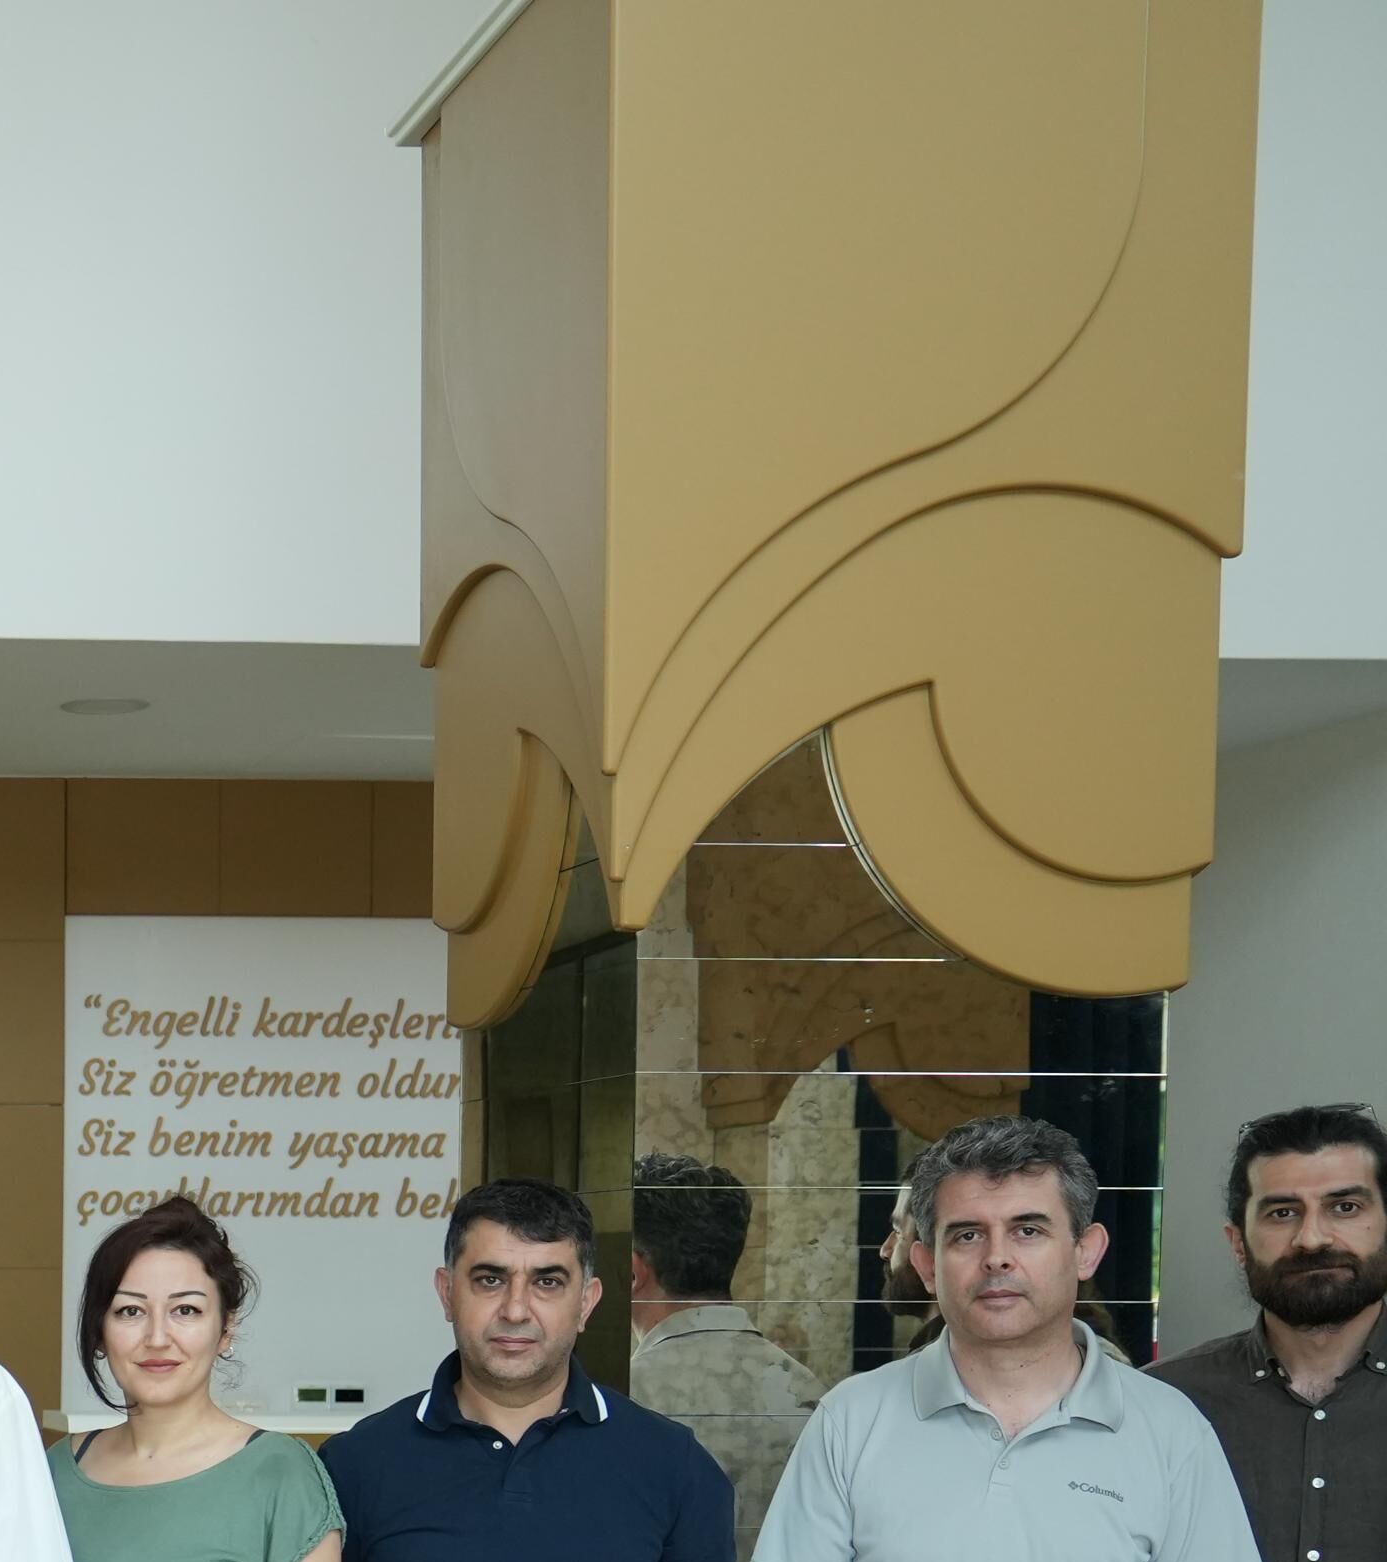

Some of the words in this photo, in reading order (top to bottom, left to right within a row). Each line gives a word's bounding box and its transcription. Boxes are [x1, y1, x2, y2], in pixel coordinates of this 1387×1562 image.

[251, 996, 461, 1049] kardeşler
[78, 1057, 137, 1097] Siz
[149, 1058, 341, 1110] öğretmen
[78, 1117, 136, 1157] Siz
[148, 1115, 273, 1157] benim
[288, 1131, 447, 1170] yaşama
[1079, 1482, 1124, 1503] Columbia
